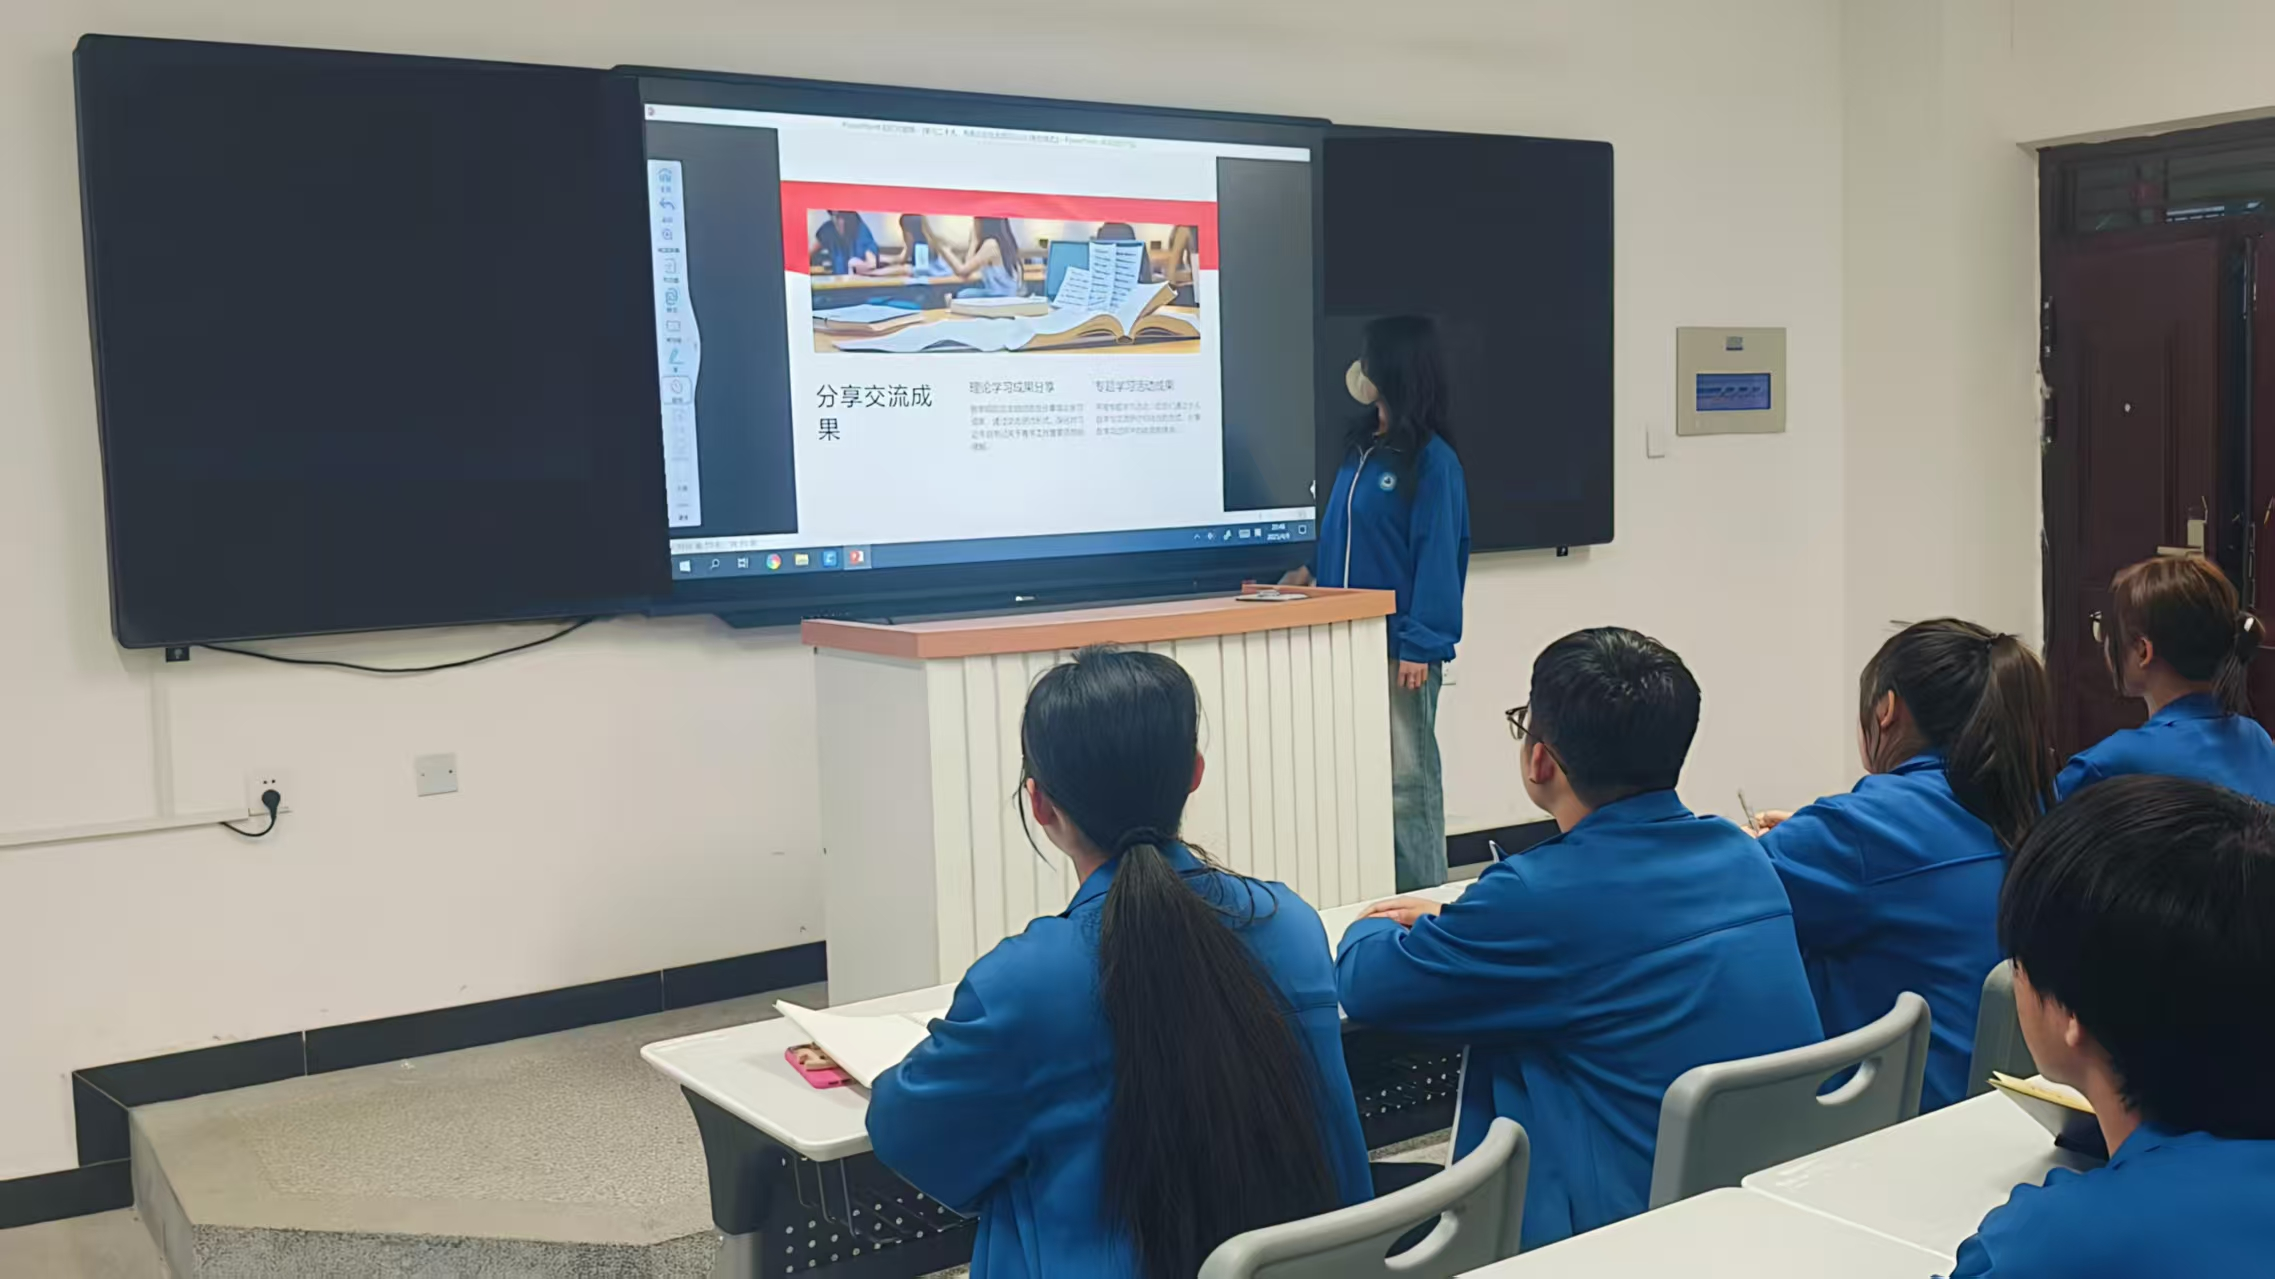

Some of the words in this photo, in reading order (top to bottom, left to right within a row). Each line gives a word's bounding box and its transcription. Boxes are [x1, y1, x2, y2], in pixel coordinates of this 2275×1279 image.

[816, 384, 933, 408] 分享交流成
[969, 381, 1055, 394] 理论学习成果分享
[818, 418, 841, 441] 果
